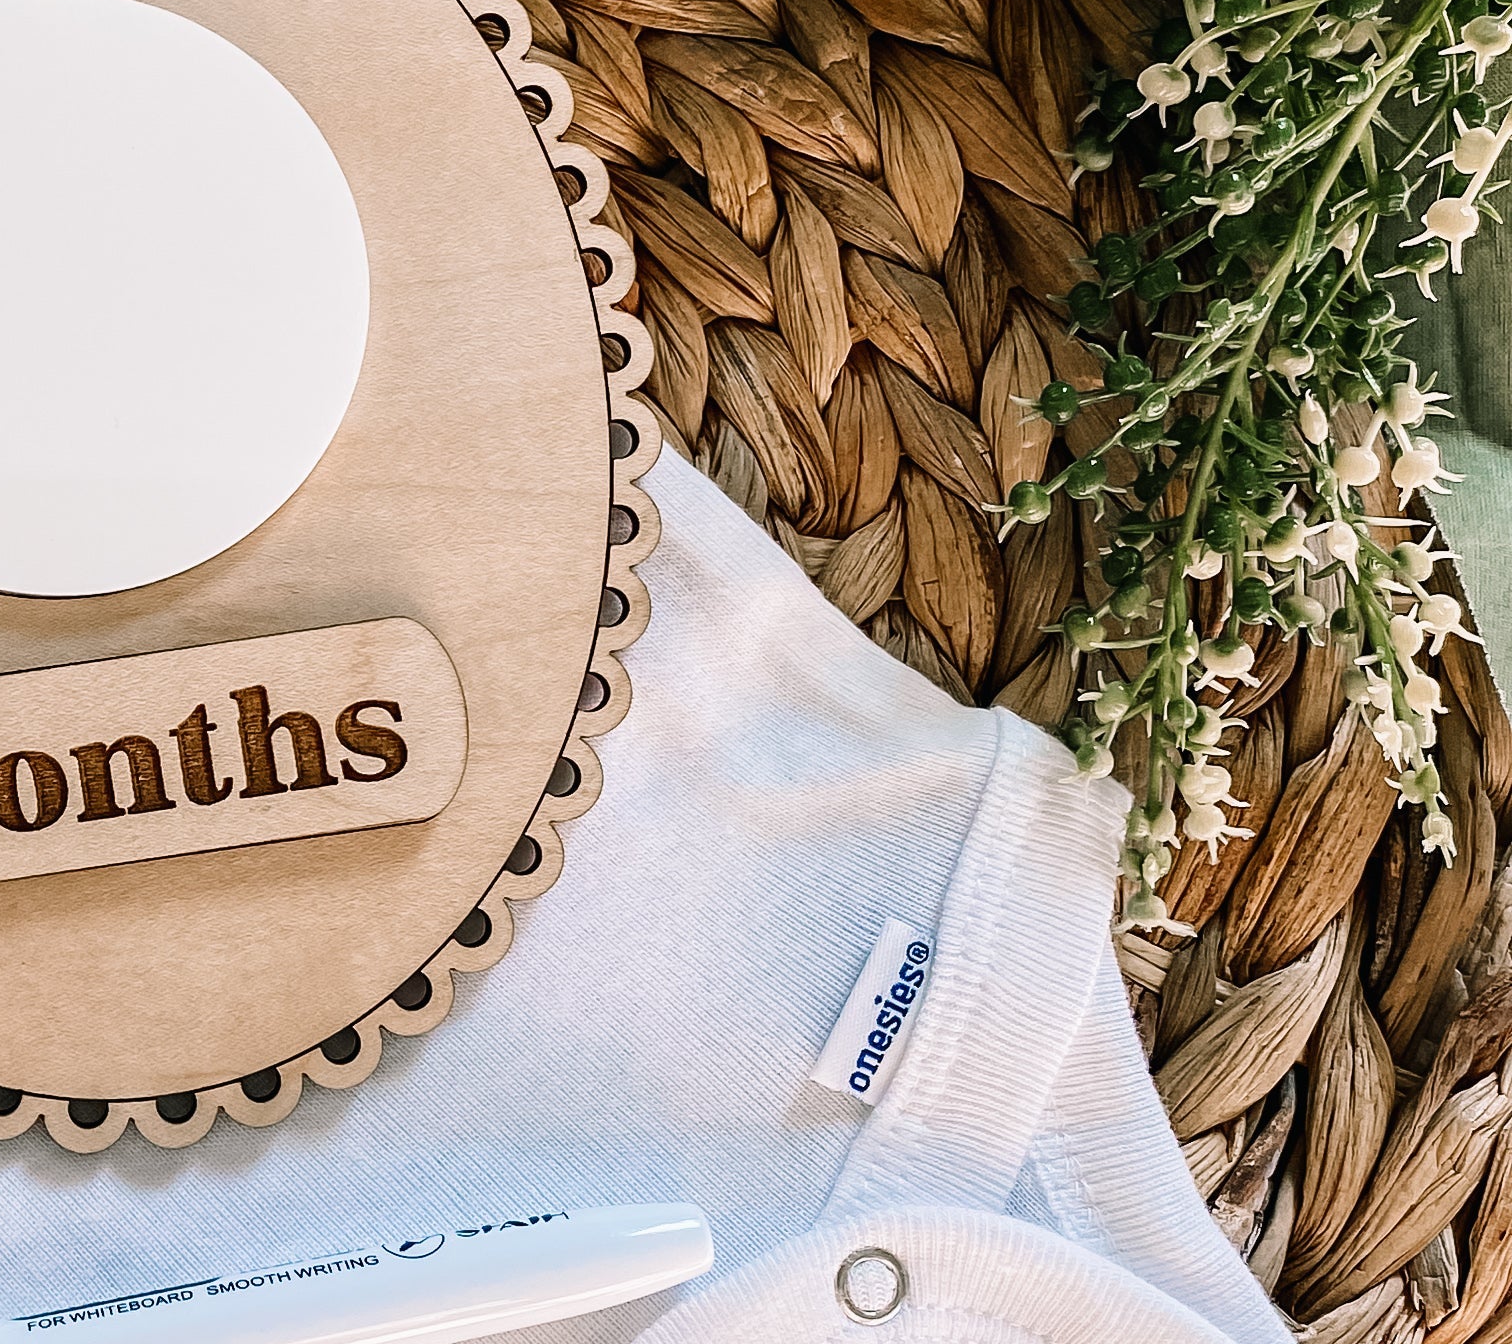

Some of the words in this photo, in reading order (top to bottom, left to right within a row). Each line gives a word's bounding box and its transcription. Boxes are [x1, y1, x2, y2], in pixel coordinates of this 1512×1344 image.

[27, 1316, 66, 1332] FOR
[69, 1290, 194, 1323] WHITEBOARD
[206, 1271, 291, 1296] SMOOTH
[294, 1255, 380, 1279] WRITING
